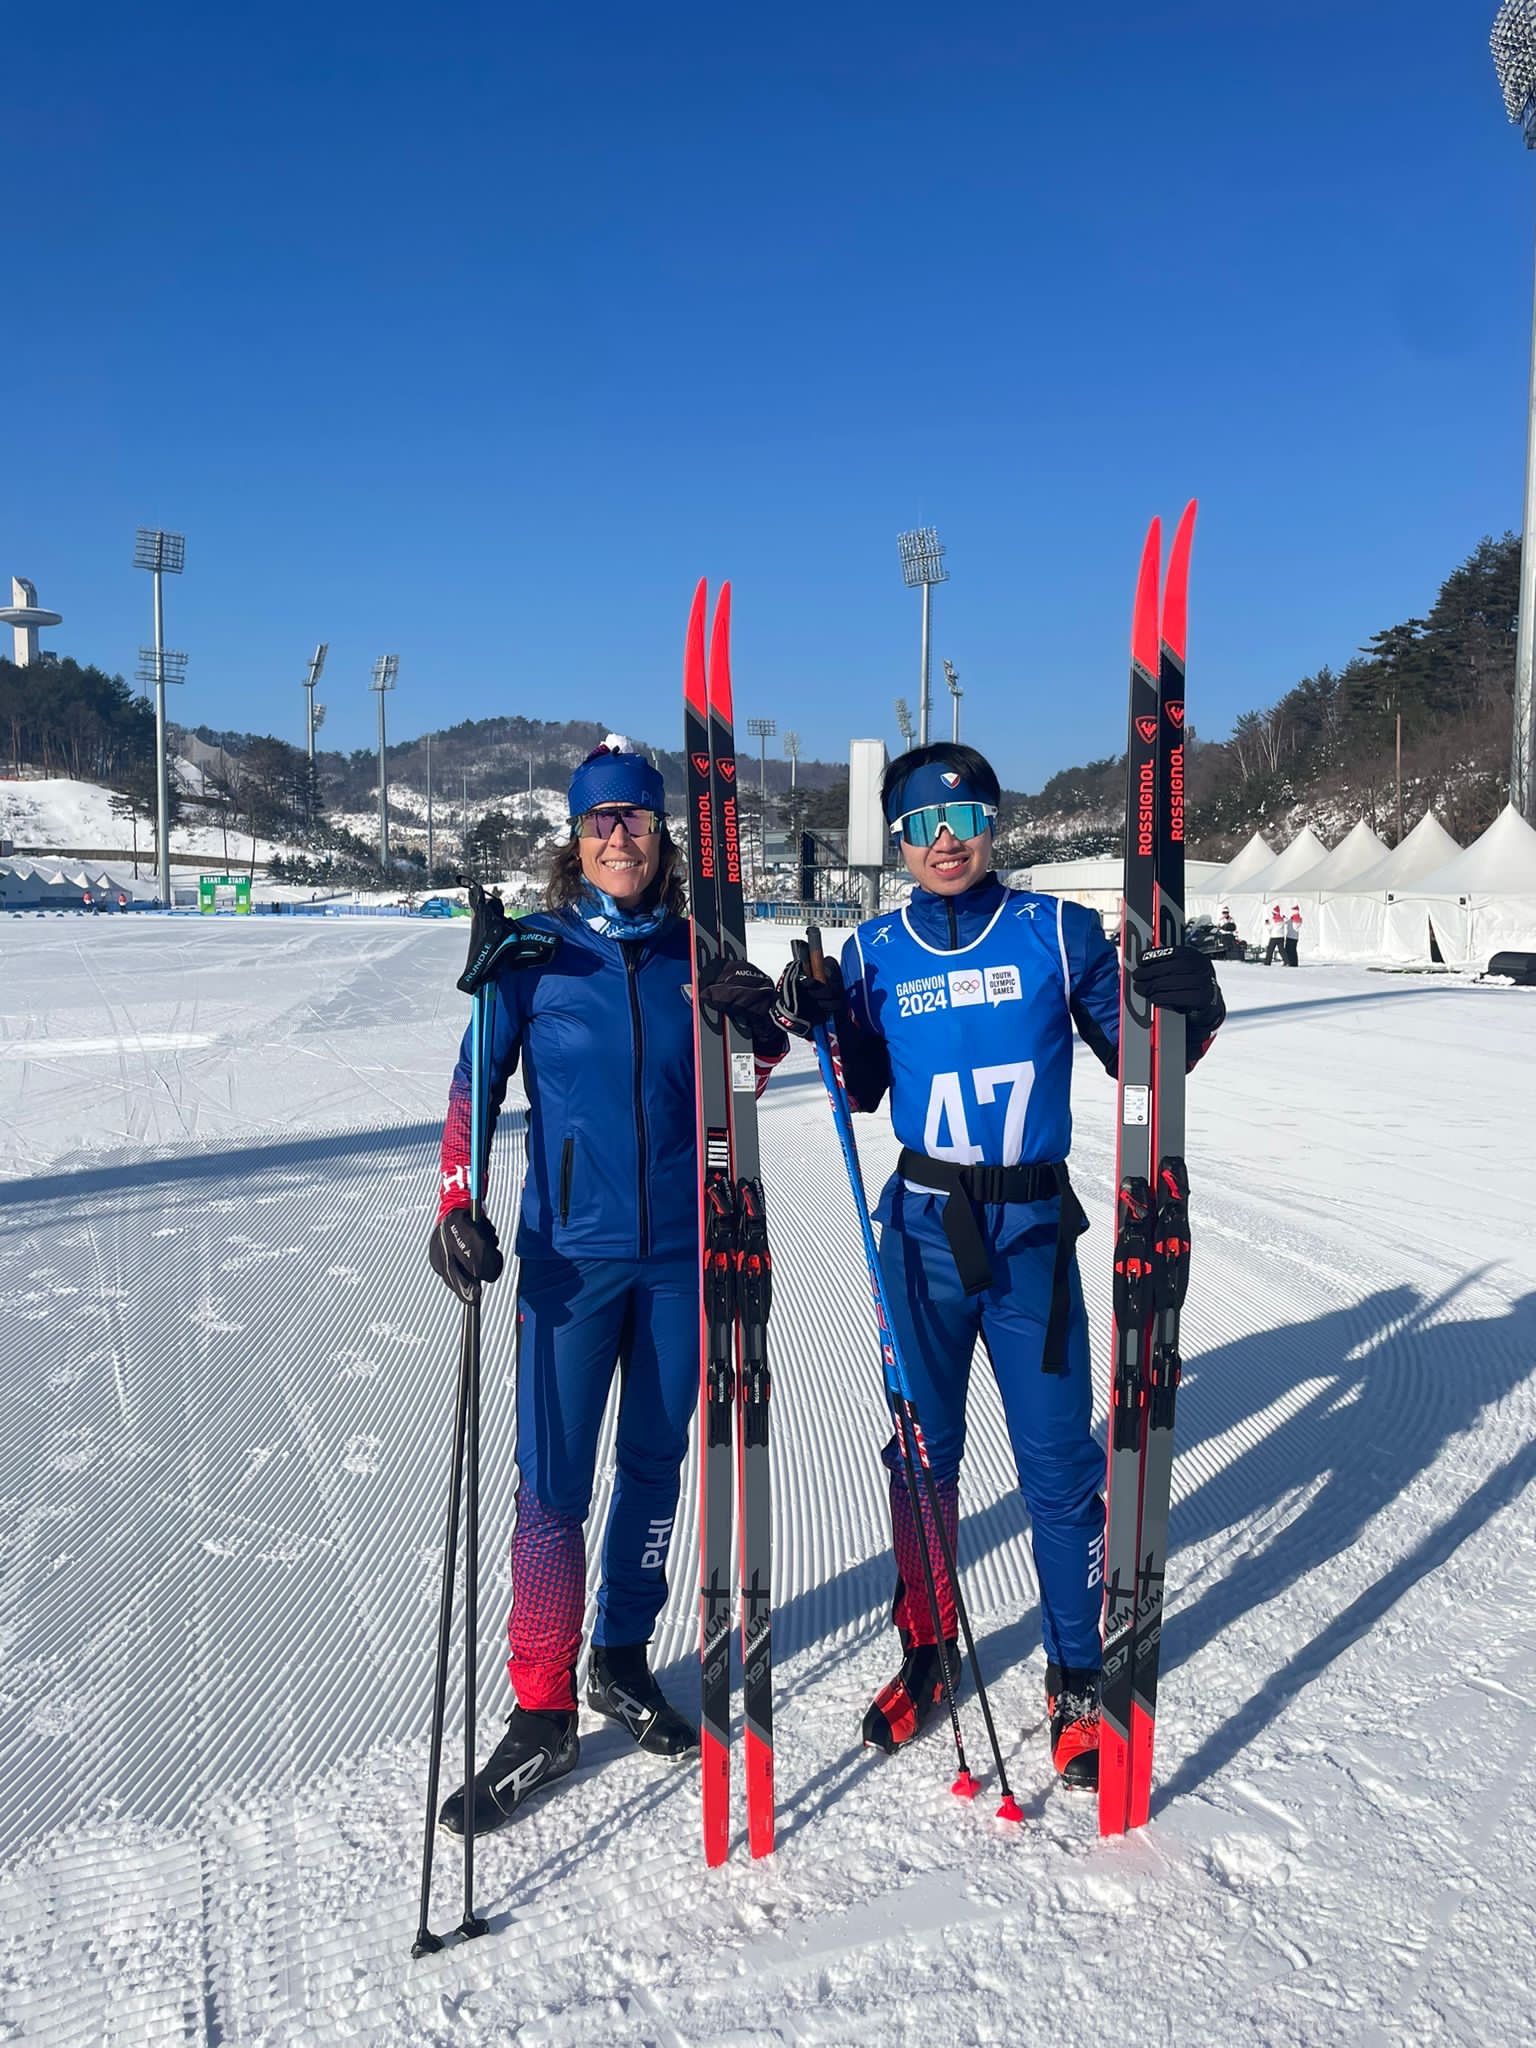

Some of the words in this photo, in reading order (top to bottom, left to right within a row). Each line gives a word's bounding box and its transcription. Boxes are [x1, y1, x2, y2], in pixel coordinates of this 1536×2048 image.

[1138, 759, 1154, 856] ROSSIGNOL
[1171, 744, 1184, 841] ROSSIGNOL
[698, 792, 714, 878] ROSSIGNOL
[724, 797, 740, 883] ROSSIGNOL
[896, 974, 946, 997] GANGWON
[989, 978, 1016, 988] OLYMPIC
[992, 971, 1012, 979] YOUTH
[993, 986, 1015, 995] GAMES
[899, 989, 948, 1018] 2024
[924, 1060, 1035, 1168] 47
[641, 1517, 673, 1568] PHI
[1087, 1533, 1104, 1589] PHI
[704, 1649, 729, 1685] 197
[745, 1649, 771, 1685] 197
